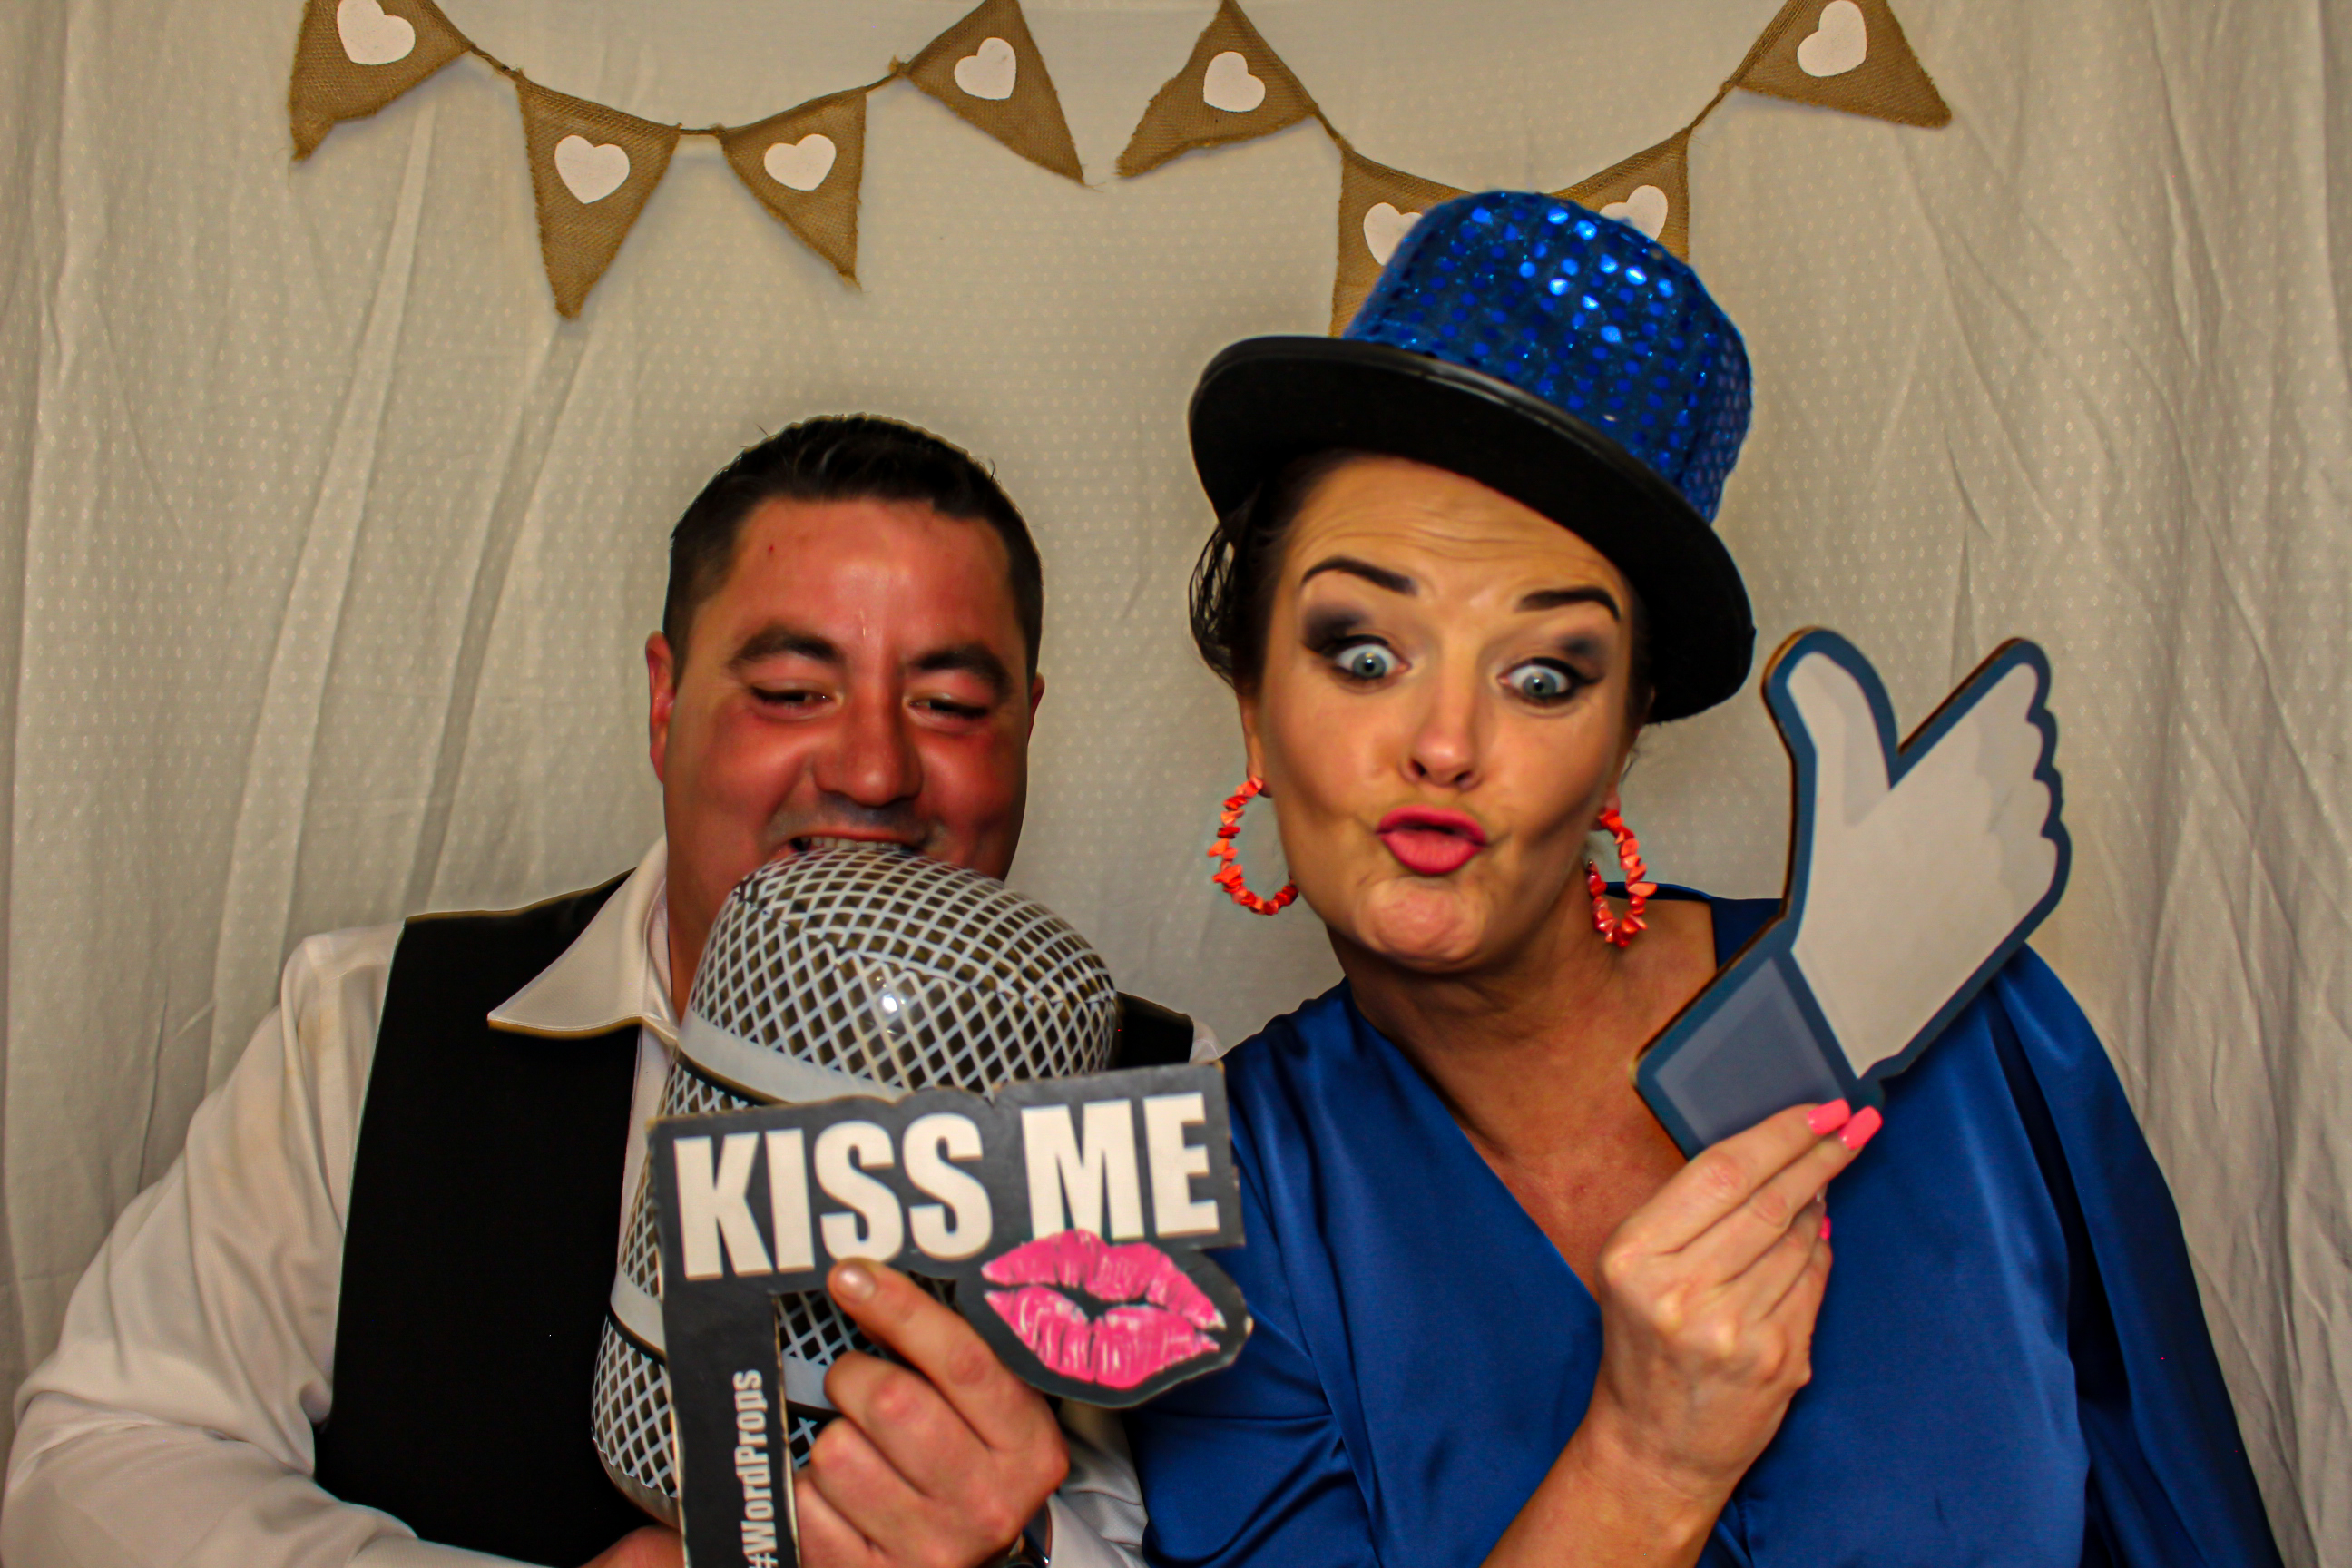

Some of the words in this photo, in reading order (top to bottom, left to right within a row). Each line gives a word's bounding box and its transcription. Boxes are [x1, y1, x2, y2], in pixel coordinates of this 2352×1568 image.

[673, 1112, 994, 1280] KISS
[1020, 1092, 1220, 1241] ME
[732, 1368, 779, 1568] #WordProps
